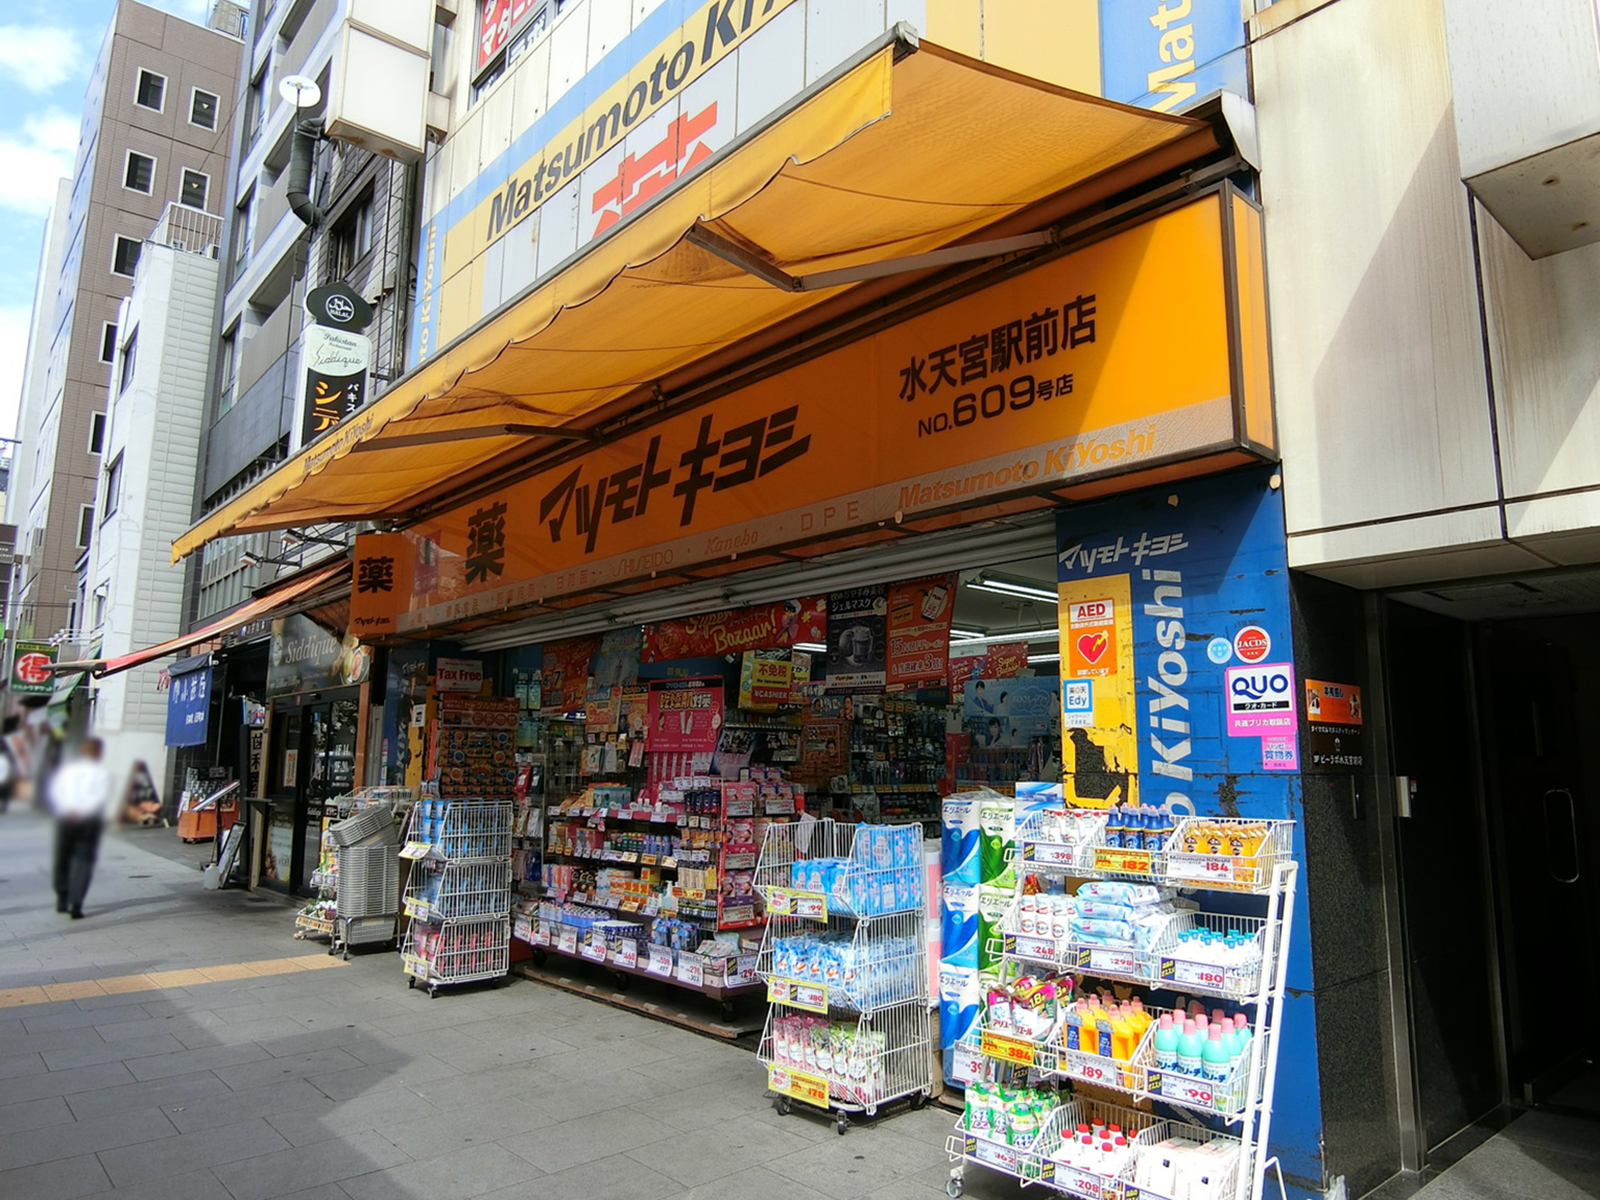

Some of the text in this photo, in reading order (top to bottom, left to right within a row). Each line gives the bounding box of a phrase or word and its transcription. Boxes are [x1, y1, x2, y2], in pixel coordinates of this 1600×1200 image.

[487, 41, 695, 242] Matsumoto
[330, 308, 350, 318] HALAL
[323, 332, 357, 347] Pakistan
[314, 343, 362, 367] Siddique
[899, 294, 1097, 402] 水天宮駅前店
[898, 424, 1157, 510] Matsumoto KiYoshi
[539, 404, 812, 554] マツモトキヨシ
[465, 501, 508, 585] 薬
[705, 527, 759, 556] Kanebo
[1058, 532, 1188, 573] マツモトキヨシ
[358, 556, 395, 593] 薬
[831, 598, 872, 612] ジェルマスク
[1077, 603, 1106, 618] AED
[685, 610, 734, 640] Super
[285, 634, 338, 666] Siddique
[1237, 639, 1268, 648] JACDS
[438, 668, 482, 682] Tax Free
[1142, 568, 1194, 782] KiYoshi
[1232, 674, 1289, 701] QUO
[1069, 695, 1088, 707] Edy
[1244, 702, 1278, 711] クオ・カード
[943, 805, 971, 815] エリエール
[981, 811, 1012, 822] エリエール
[1053, 851, 1072, 861] 398
[1122, 860, 1148, 871] 182
[1206, 861, 1229, 872] 184
[944, 885, 975, 898] エリエール
[980, 896, 1012, 908] エリエール
[1035, 945, 1055, 956] 248
[1113, 957, 1133, 967] 298
[939, 975, 969, 989] エリエール
[1200, 972, 1224, 983] 180
[1008, 1046, 1032, 1061] 384
[1082, 1065, 1104, 1079] 189
[808, 1087, 825, 1099] 178
[1187, 1088, 1212, 1101] 90
[1077, 1179, 1100, 1193] 208
